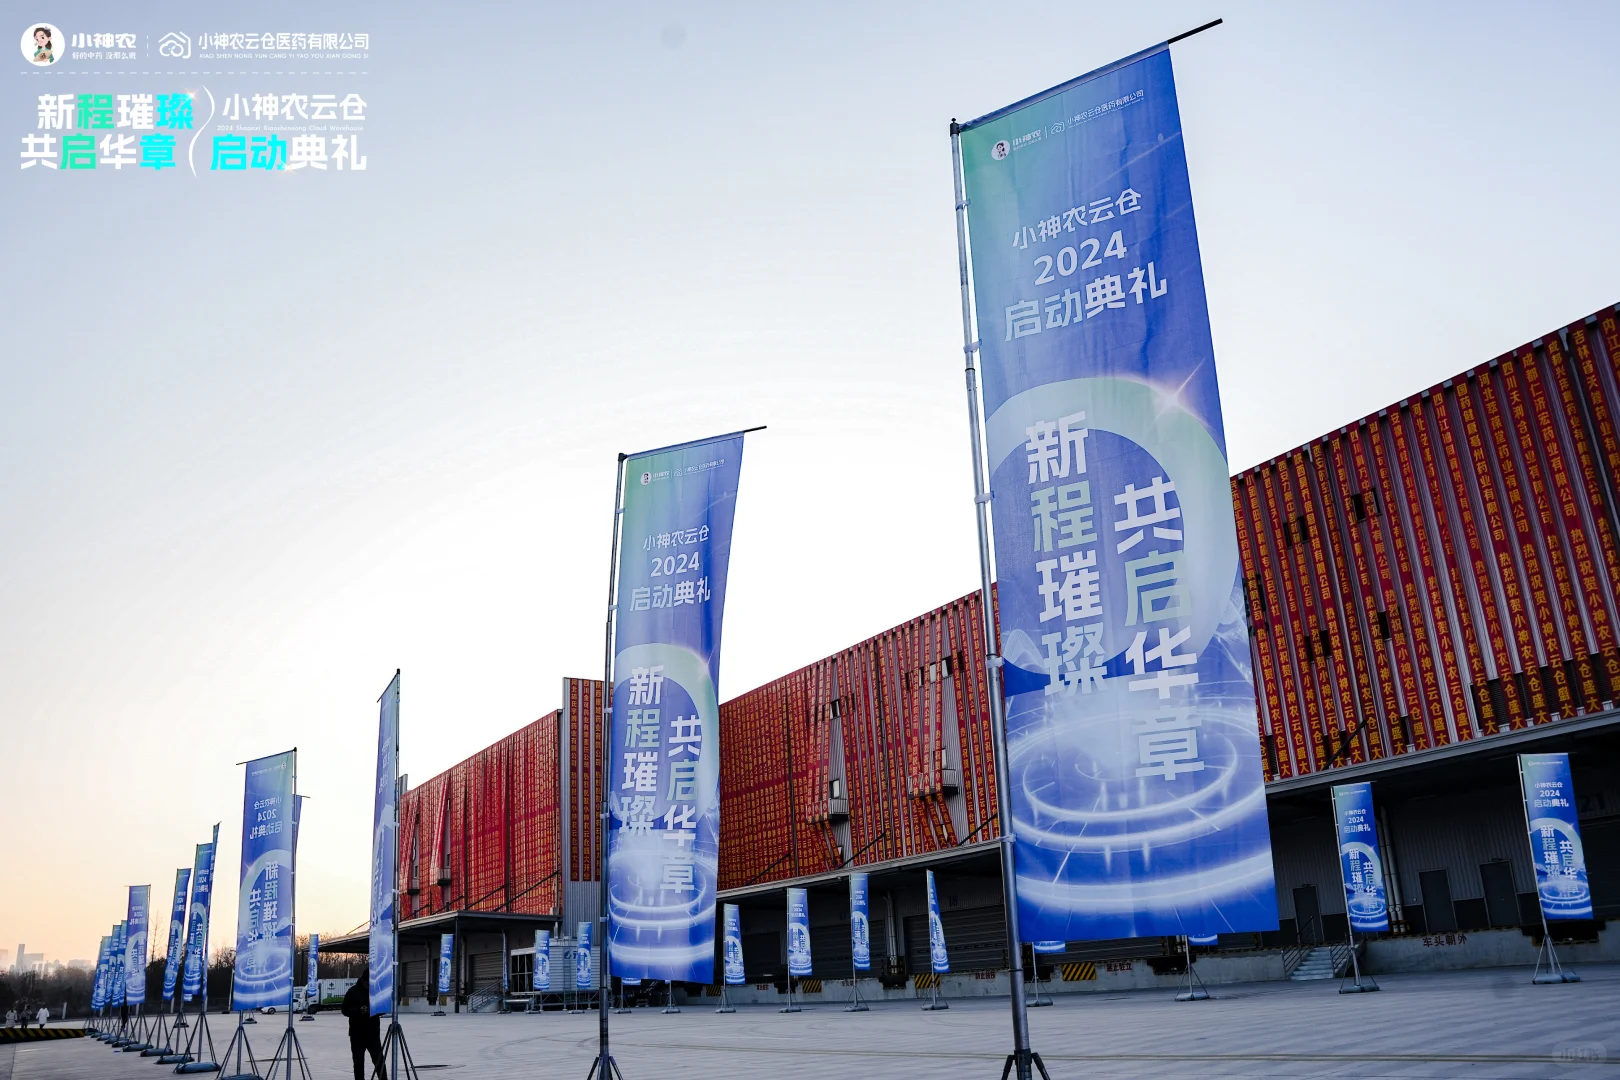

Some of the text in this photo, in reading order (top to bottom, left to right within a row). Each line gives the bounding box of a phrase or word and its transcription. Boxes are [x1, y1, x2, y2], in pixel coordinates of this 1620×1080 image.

[1012, 188, 1141, 249] 小神农云仓
[1033, 230, 1127, 285] 2024
[1004, 261, 1167, 341] 启动典礼
[643, 524, 709, 551] 小神农云仓
[650, 552, 700, 577] 2024
[1025, 411, 1108, 696] 新程璀璨
[629, 576, 710, 611] 启动典礼
[1113, 476, 1204, 782] 共启华章
[618, 665, 664, 836] 新程璀璨
[659, 714, 702, 894] 共启华章
[1347, 816, 1364, 824] 2024
[1539, 789, 1560, 797] 2024
[1422, 934, 1467, 947] 车头朝外
